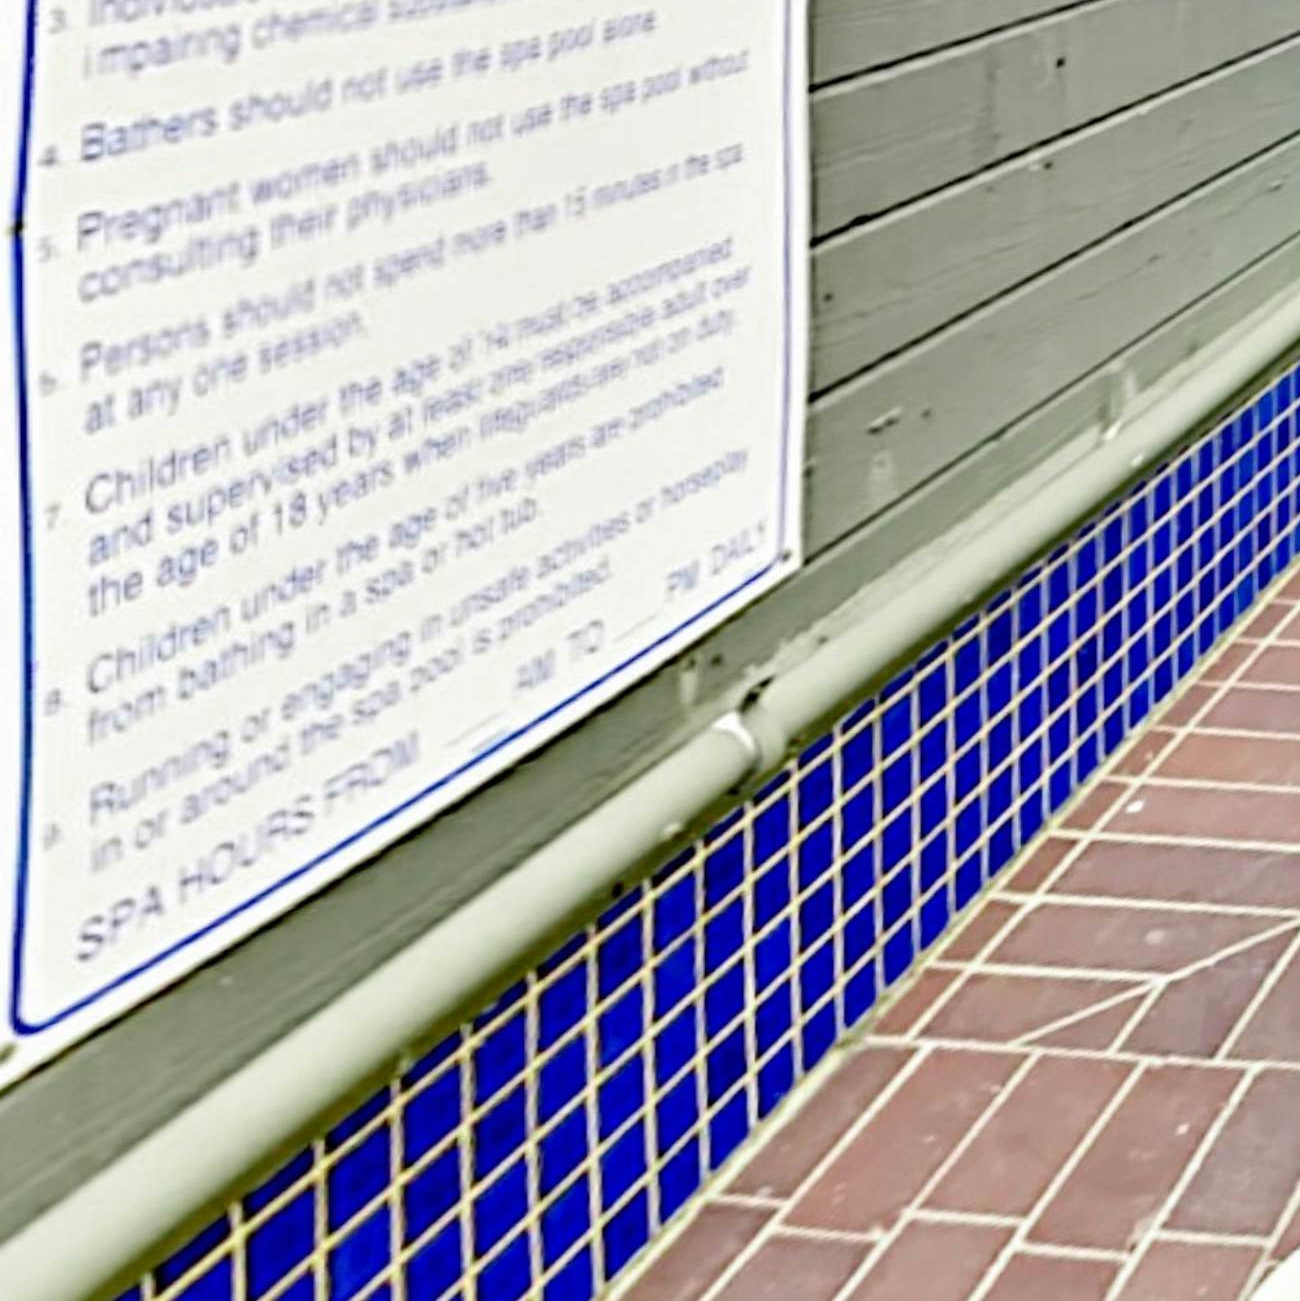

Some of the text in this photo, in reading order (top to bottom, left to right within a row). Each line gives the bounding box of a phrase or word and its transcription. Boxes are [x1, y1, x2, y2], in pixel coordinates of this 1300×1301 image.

[76, 67, 683, 253] Pregnant women should not use the spa pool
[80, 105, 219, 164] Bathers
[228, 75, 334, 132] should
[341, 67, 389, 102] not
[395, 57, 443, 91] use
[452, 47, 491, 77] the
[498, 35, 542, 71] spa
[547, 19, 596, 62] pool
[79, 204, 339, 303] consulting their
[79, 318, 210, 383] Persons
[223, 277, 316, 339] should
[325, 264, 365, 300] not
[373, 235, 444, 290] spend
[452, 217, 507, 255] more
[513, 201, 557, 238] than
[83, 353, 249, 437] at any one
[83, 337, 473, 516] Children under the age of
[88, 509, 156, 568] and
[166, 433, 338, 534] supervised
[348, 422, 379, 460] by
[387, 404, 413, 442] at
[423, 379, 484, 422] least
[87, 426, 471, 618] the age of 18 years when
[87, 605, 231, 695] Children
[242, 558, 327, 621] under
[336, 533, 379, 575] the
[387, 506, 436, 551] age
[444, 483, 469, 521] of
[87, 518, 495, 745] from bathing in a spa or hot
[75, 885, 165, 963] SPA
[178, 793, 317, 901] HOURS
[323, 728, 418, 811] FROM
[514, 647, 556, 693] AM
[565, 618, 605, 655] TO
[664, 557, 700, 599] PM
[88, 727, 232, 827] Running
[239, 706, 273, 743] or
[280, 627, 412, 722] engaging
[88, 835, 124, 873] in
[134, 809, 171, 850] or
[179, 734, 292, 825] around
[298, 712, 345, 757] the
[350, 678, 402, 727] spa
[409, 647, 464, 693] pool
